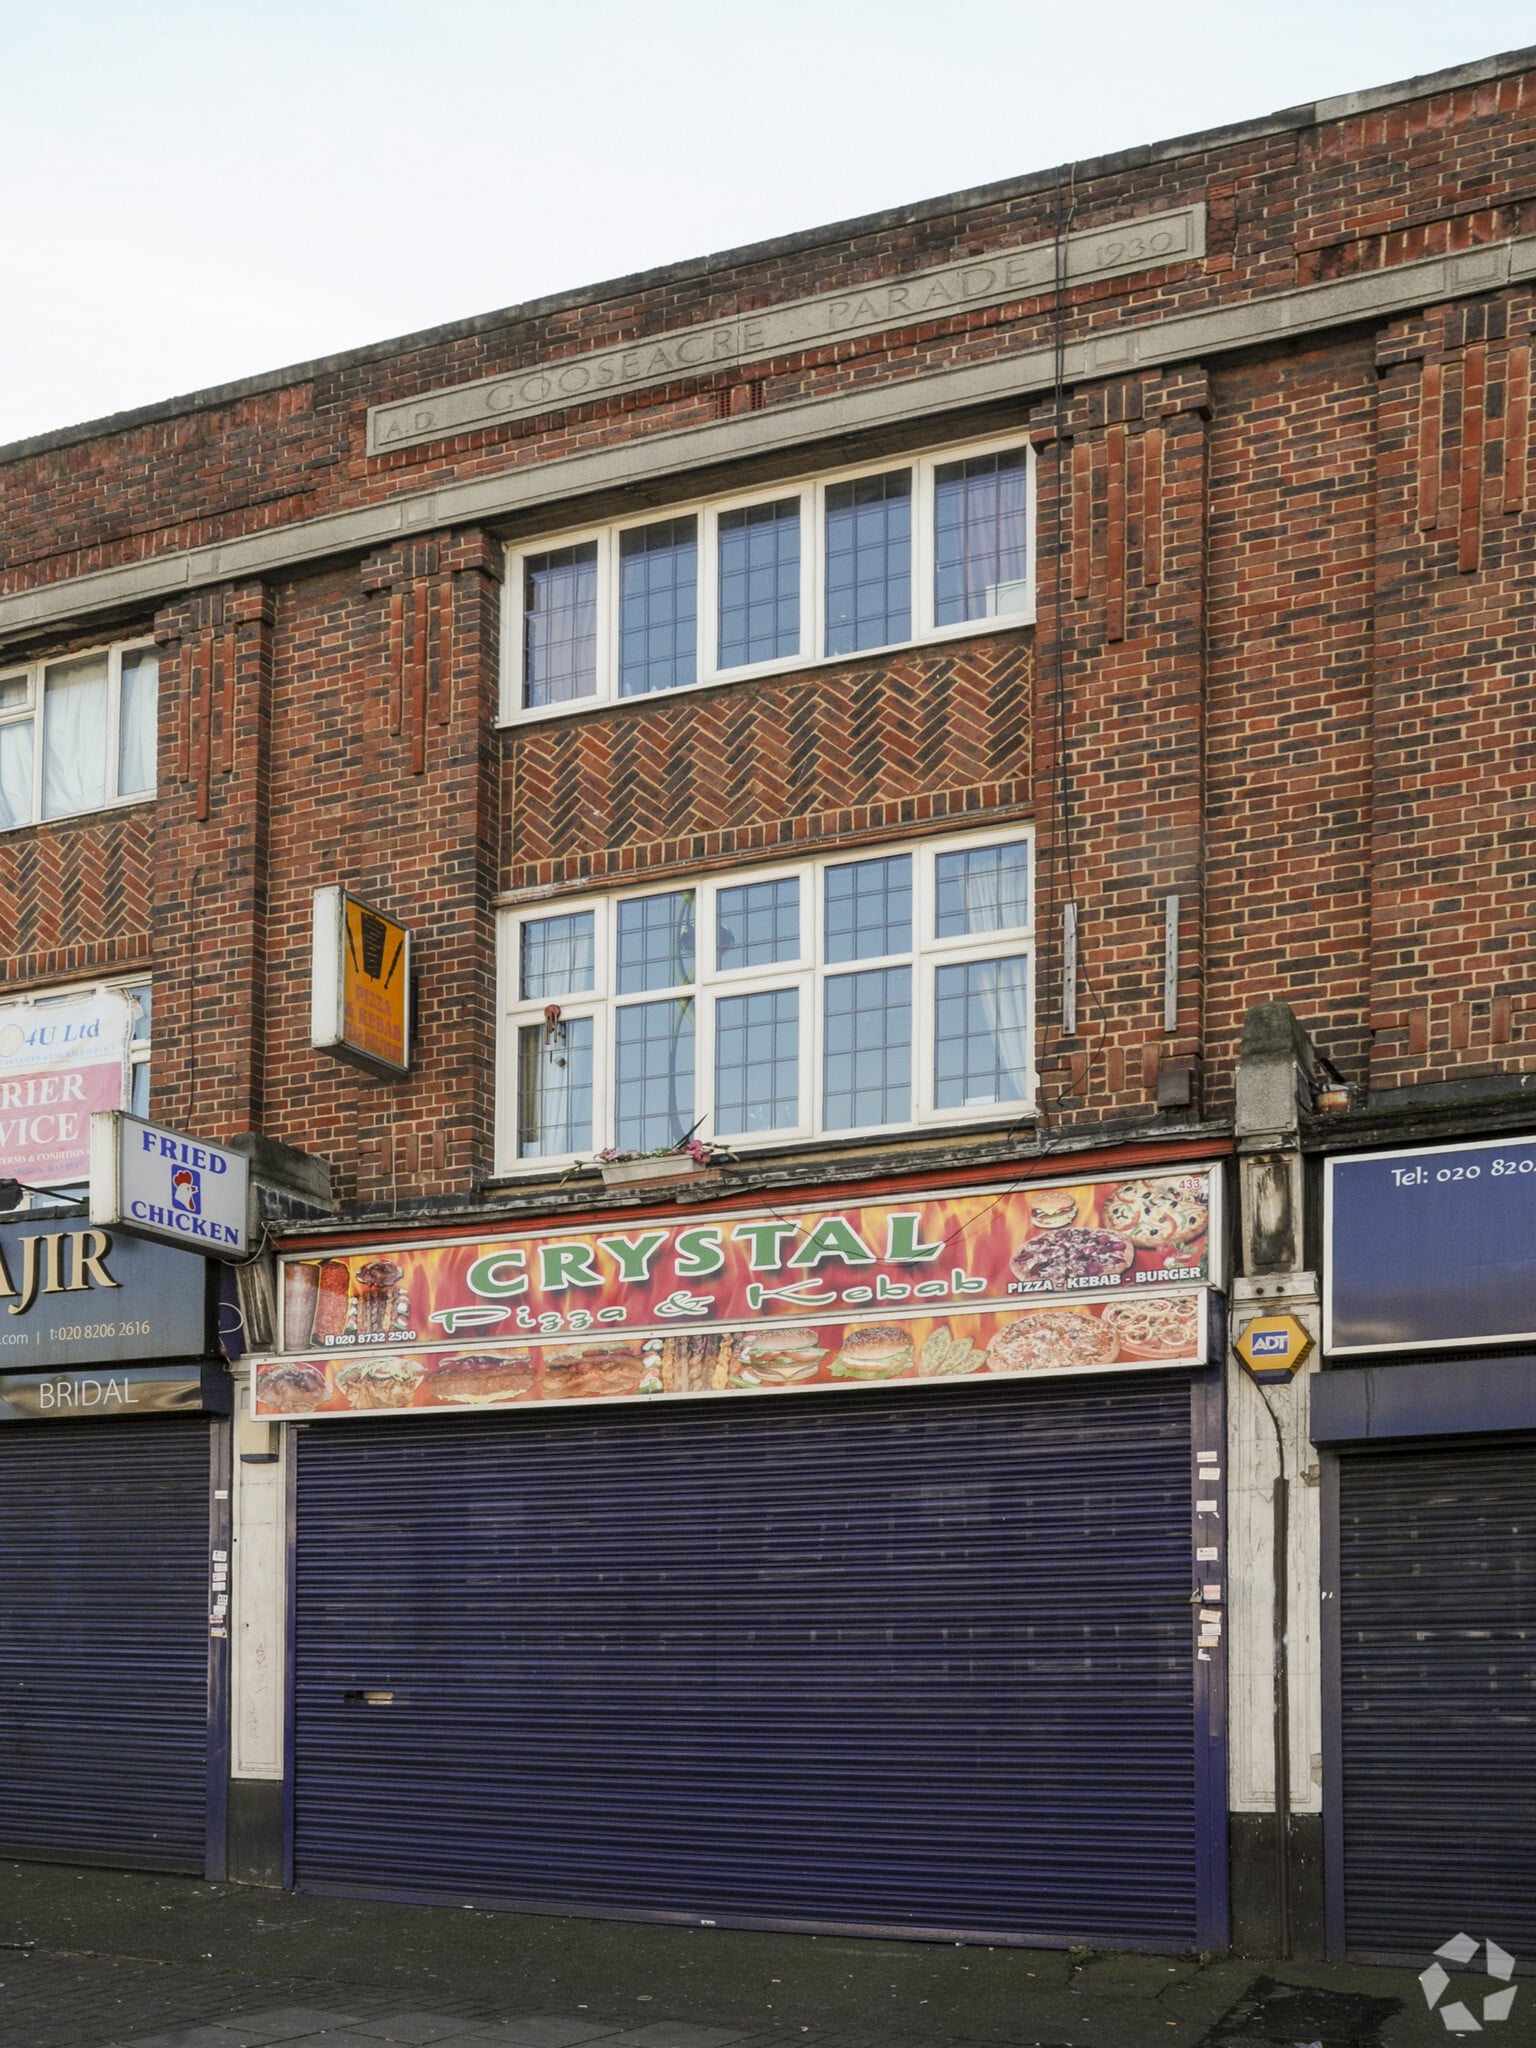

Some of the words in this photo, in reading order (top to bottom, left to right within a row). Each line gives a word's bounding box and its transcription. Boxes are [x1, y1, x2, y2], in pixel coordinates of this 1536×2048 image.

[486, 322, 765, 412] GOOSEACRE
[829, 256, 1029, 330] PARADE
[1095, 231, 1172, 266] 1930
[63, 1018, 100, 1042] Ltd
[359, 1008, 401, 1042] KEBAB
[142, 1130, 227, 1175] FRIED
[1178, 1178, 1201, 1190] 433
[1391, 1166, 1429, 1187] Tel:
[1436, 1166, 1481, 1183] 020
[1490, 1158, 1536, 1177] 820
[131, 1200, 239, 1245] CHICKEN
[466, 1212, 946, 1298] CRYSTAL
[1007, 1280, 1053, 1294] PIZZA
[1067, 1274, 1121, 1289] KEBAB
[1136, 1267, 1201, 1283] BURGER
[429, 1304, 627, 1334] Pizza
[654, 1290, 715, 1318] &
[747, 1268, 987, 1310] Kebab
[84, 1323, 115, 1339] 8206
[119, 1320, 150, 1336] 2616
[335, 1334, 355, 1345] 020
[358, 1332, 385, 1344] 8732
[388, 1330, 416, 1341] 2500
[1252, 1334, 1288, 1351] ADT
[39, 1378, 139, 1408] BRIDAL
